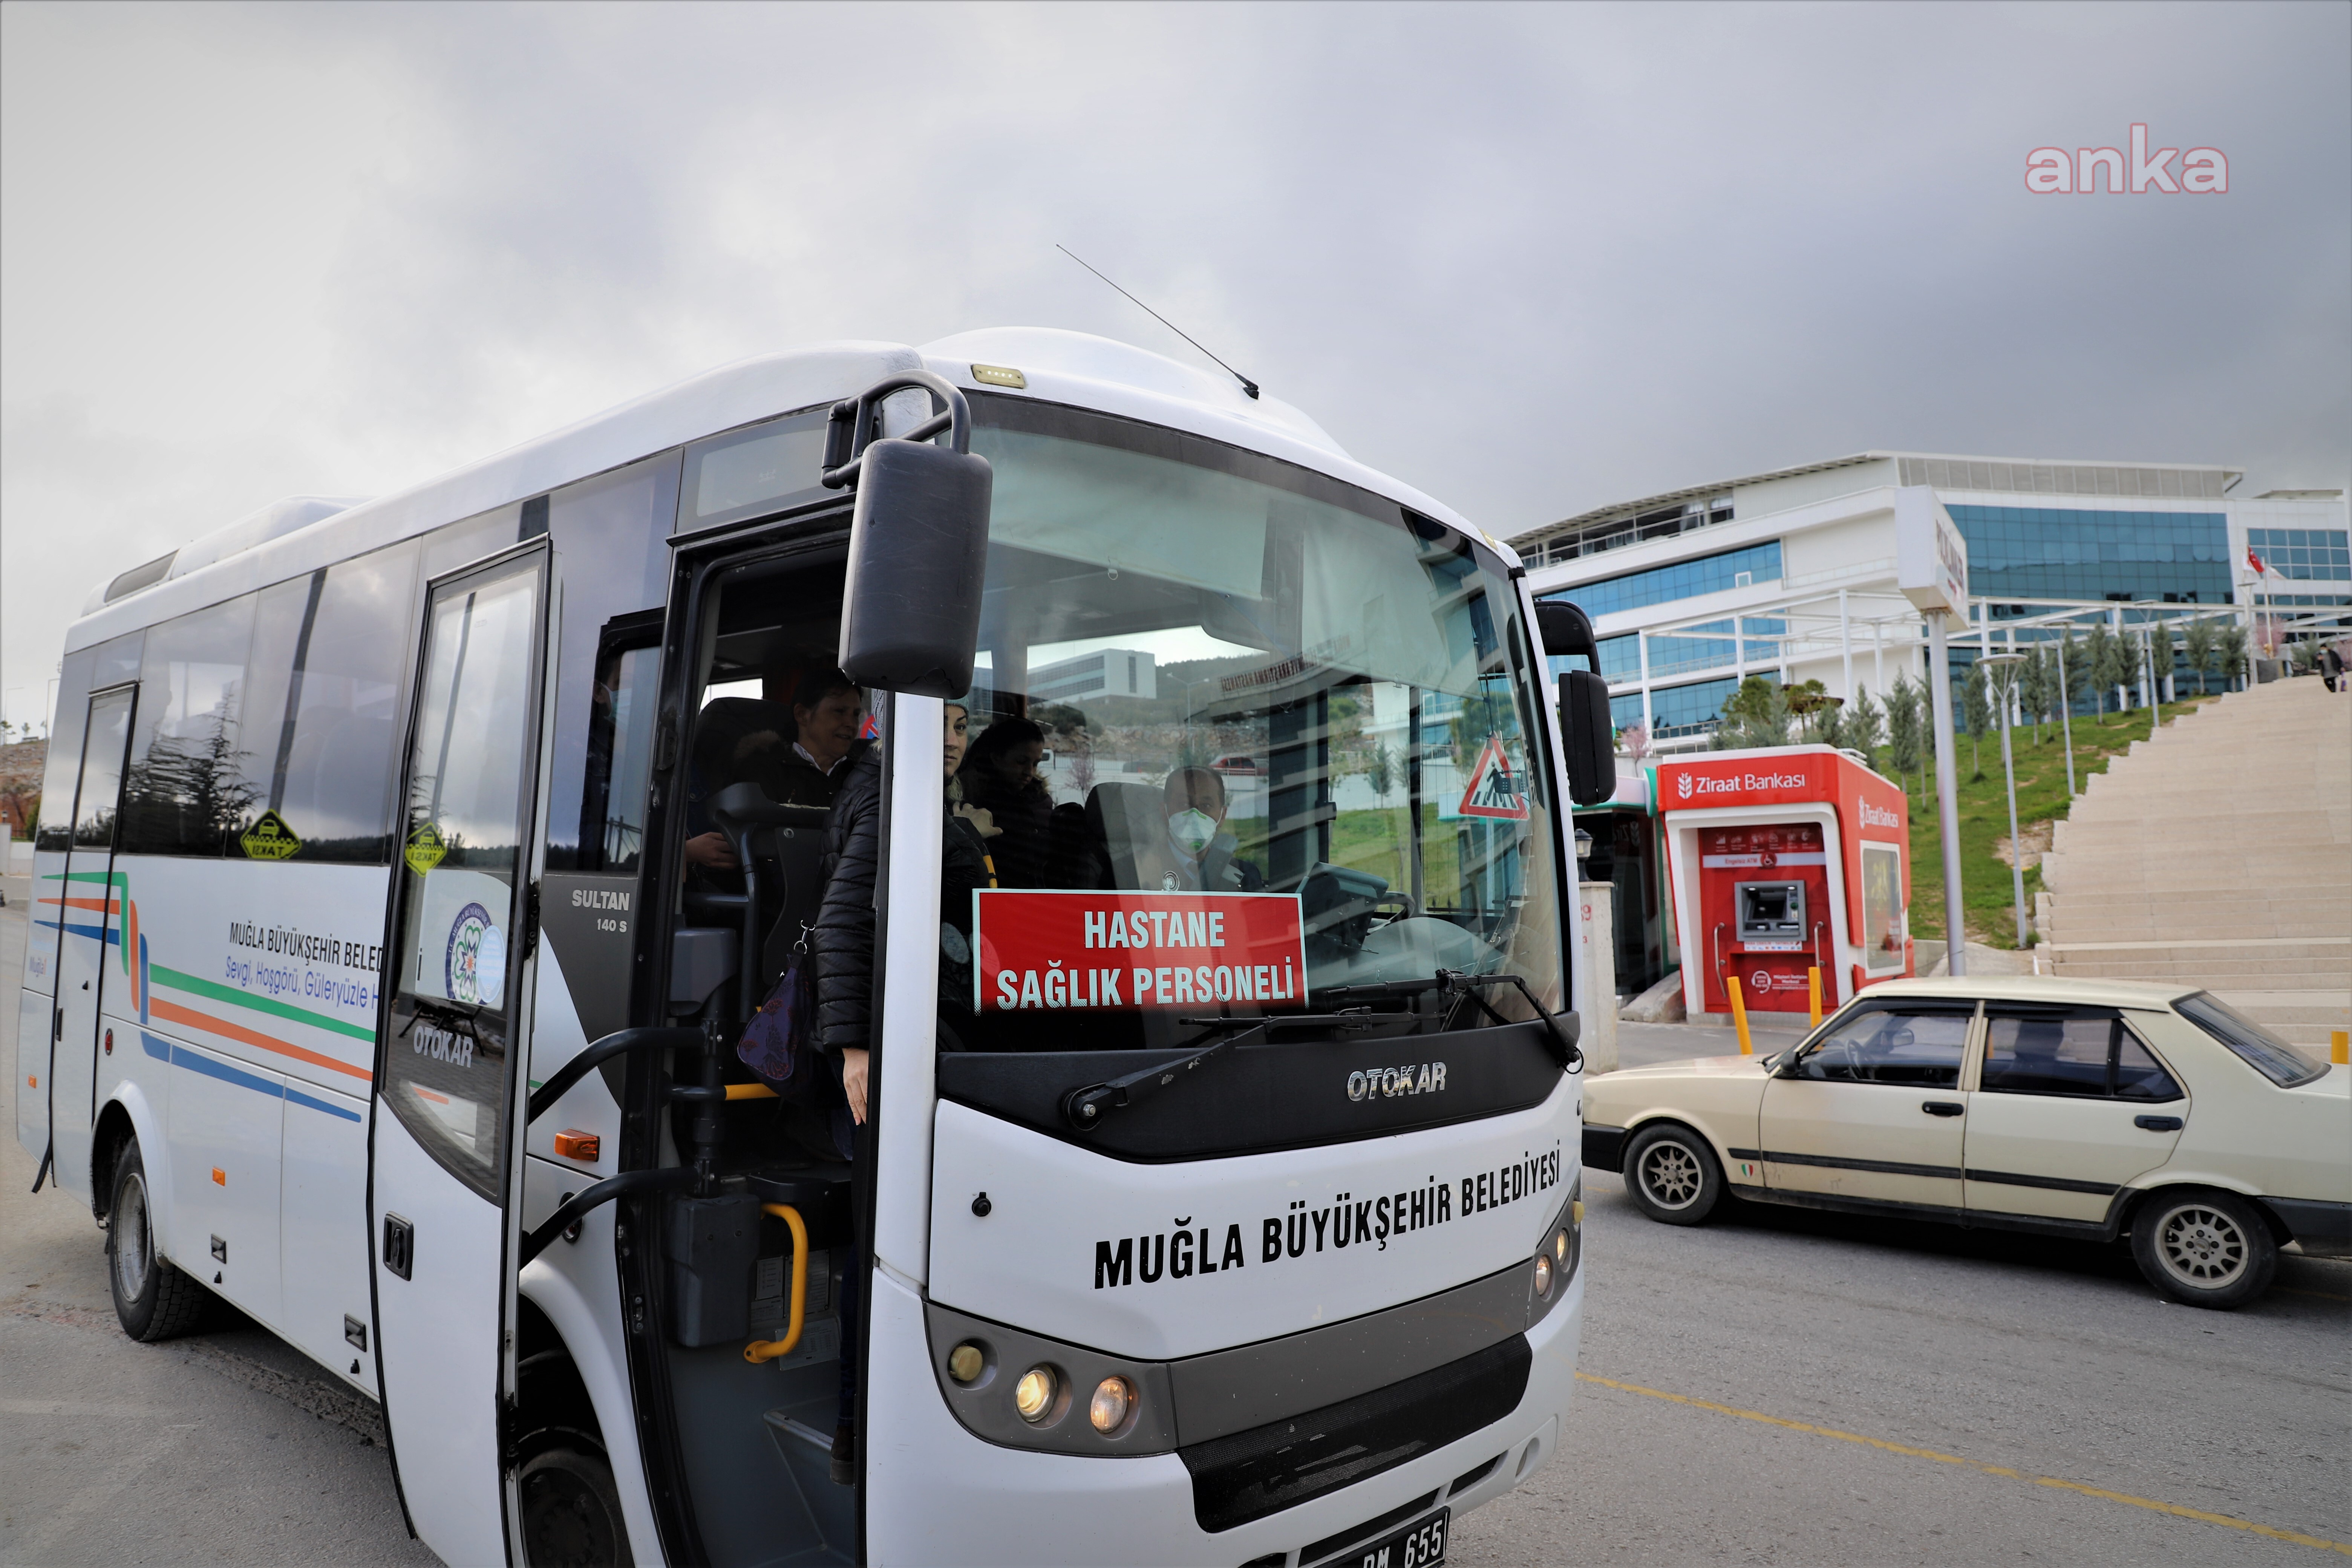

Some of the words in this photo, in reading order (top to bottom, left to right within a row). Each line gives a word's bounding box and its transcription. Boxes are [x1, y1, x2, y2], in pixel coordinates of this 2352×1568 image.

[1696, 776, 1741, 793] Ziraat
[1744, 772, 1805, 790] Bankası
[572, 889, 630, 911] SULTAN
[230, 920, 264, 949] MUĞLA
[268, 925, 340, 966] BÜYÜKŞEHİR
[597, 918, 617, 932] 140
[619, 920, 627, 933] S
[1084, 911, 1225, 948] HASTANE
[226, 956, 253, 987] Sevgi,
[256, 962, 300, 995] Hoşgörü,
[305, 971, 368, 1008] Güleryüzle
[997, 960, 1123, 1010] SAĞLIK
[1133, 956, 1294, 1005] PERSONELİ
[413, 1025, 473, 1068] OTOKAR
[1347, 1061, 1447, 1098] OTOKAR
[1095, 1216, 1245, 1289] MUĞLA
[1262, 1175, 1451, 1252] BÜYÜKŞEHİR
[1461, 1139, 1560, 1216] BELEDİYESİ
[1404, 1519, 1443, 1568] 655
